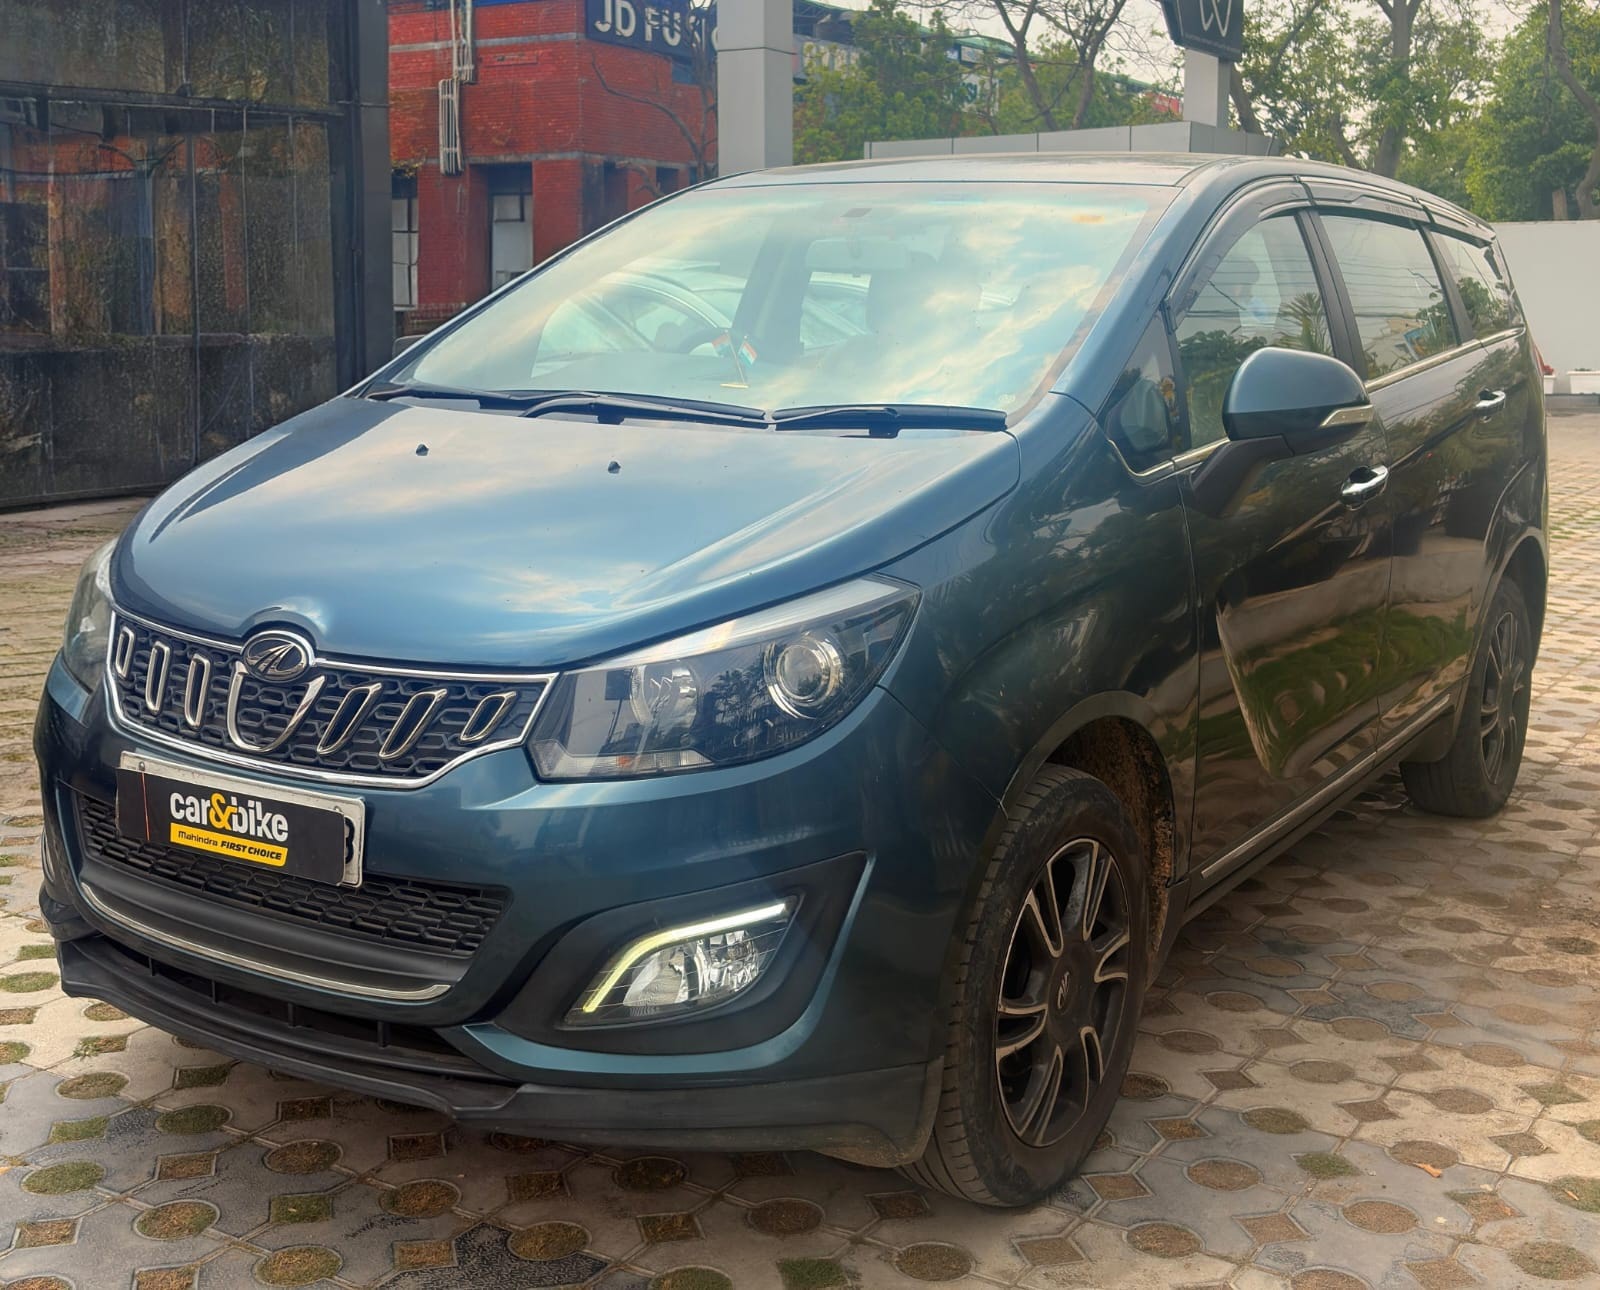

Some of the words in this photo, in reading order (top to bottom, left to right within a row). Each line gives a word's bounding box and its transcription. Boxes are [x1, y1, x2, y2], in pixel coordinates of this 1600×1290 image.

[594, 0, 636, 37] JD
[170, 792, 289, 842] car&bike
[178, 830, 218, 847] Mahindra
[220, 840, 248, 853] FIRST
[247, 846, 283, 861] CHOICE
